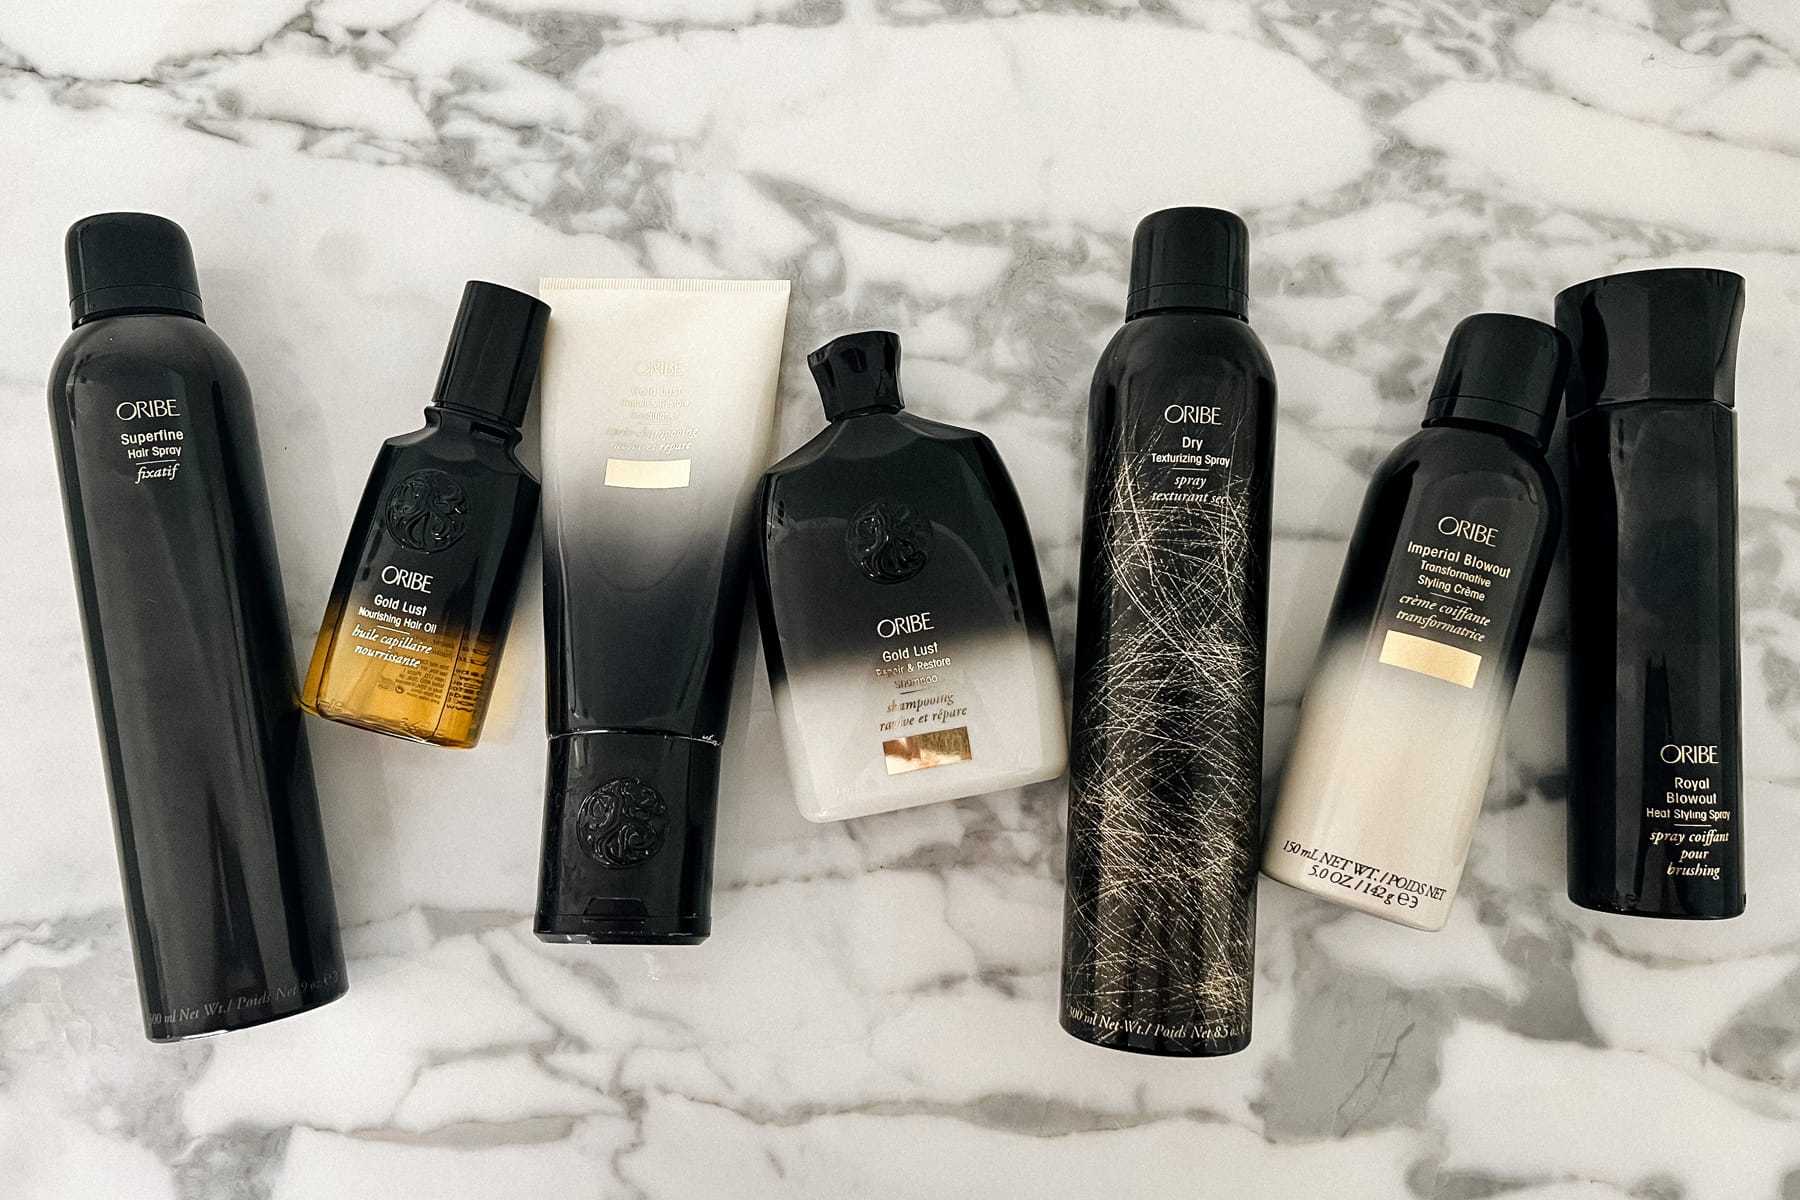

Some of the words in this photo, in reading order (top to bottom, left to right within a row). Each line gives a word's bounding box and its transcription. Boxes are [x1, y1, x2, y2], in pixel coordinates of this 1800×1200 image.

[116, 399, 181, 421] ORIBE
[1164, 404, 1224, 426] ORIBE
[120, 429, 184, 445] Superfine
[1182, 436, 1204, 451] Dry
[128, 447, 149, 459] Hair
[152, 446, 181, 457] Spray
[1151, 453, 1202, 466] Texturizing
[1204, 454, 1231, 469] Spray
[134, 463, 180, 484] fixatif
[1174, 476, 1207, 490] spray
[1151, 491, 1209, 503] texturant
[1210, 494, 1228, 504] sec
[1438, 516, 1499, 548] ORIBE
[1407, 541, 1461, 563] Imperial
[1463, 553, 1512, 579] Blowout
[381, 565, 434, 594] ORIBE
[1419, 560, 1492, 588] Transformative
[1417, 574, 1452, 593] Styling
[1453, 583, 1486, 602] Crème
[374, 594, 400, 610] Gold
[402, 602, 427, 617] Lust
[1399, 594, 1438, 611] crème
[1439, 604, 1492, 627] coiffante
[358, 606, 402, 628] Nourishing
[403, 619, 422, 633] Hair
[423, 622, 438, 634] Oil
[877, 612, 935, 639] ORIBE
[1395, 610, 1486, 643] transformatrice
[351, 624, 379, 641] huile
[380, 634, 433, 655] capillaire
[354, 644, 421, 668] nourrissante
[882, 647, 910, 663] Gold
[913, 641, 939, 657] Lust
[906, 662, 915, 673] &
[916, 656, 951, 671] Restore
[918, 713, 928, 724] et
[932, 706, 968, 724] répare
[1660, 744, 1720, 765] ORIBE
[1674, 777, 1710, 792] Royal
[1666, 791, 1717, 805] Blowout
[1646, 807, 1671, 819] Heat
[1673, 808, 1707, 822] Styling
[1708, 809, 1731, 821] Spray
[1649, 831, 1686, 846] spray
[1688, 828, 1730, 847] coiffant
[1678, 849, 1710, 863] pour
[1282, 840, 1302, 854] 150
[1300, 848, 1320, 861] mL
[1318, 852, 1354, 871] NET
[1354, 862, 1381, 882] WT.
[1386, 874, 1428, 895] POIDS
[1426, 884, 1448, 901] NET
[1307, 864, 1329, 880] 5.0
[1329, 871, 1354, 889] OZ
[1666, 861, 1721, 881] brushing
[179, 1007, 199, 1022] Net
[236, 991, 272, 1010] Poids
[1098, 1016, 1119, 1031] Net
[1153, 1025, 1187, 1039] Poids
[1190, 1024, 1212, 1040] Net
